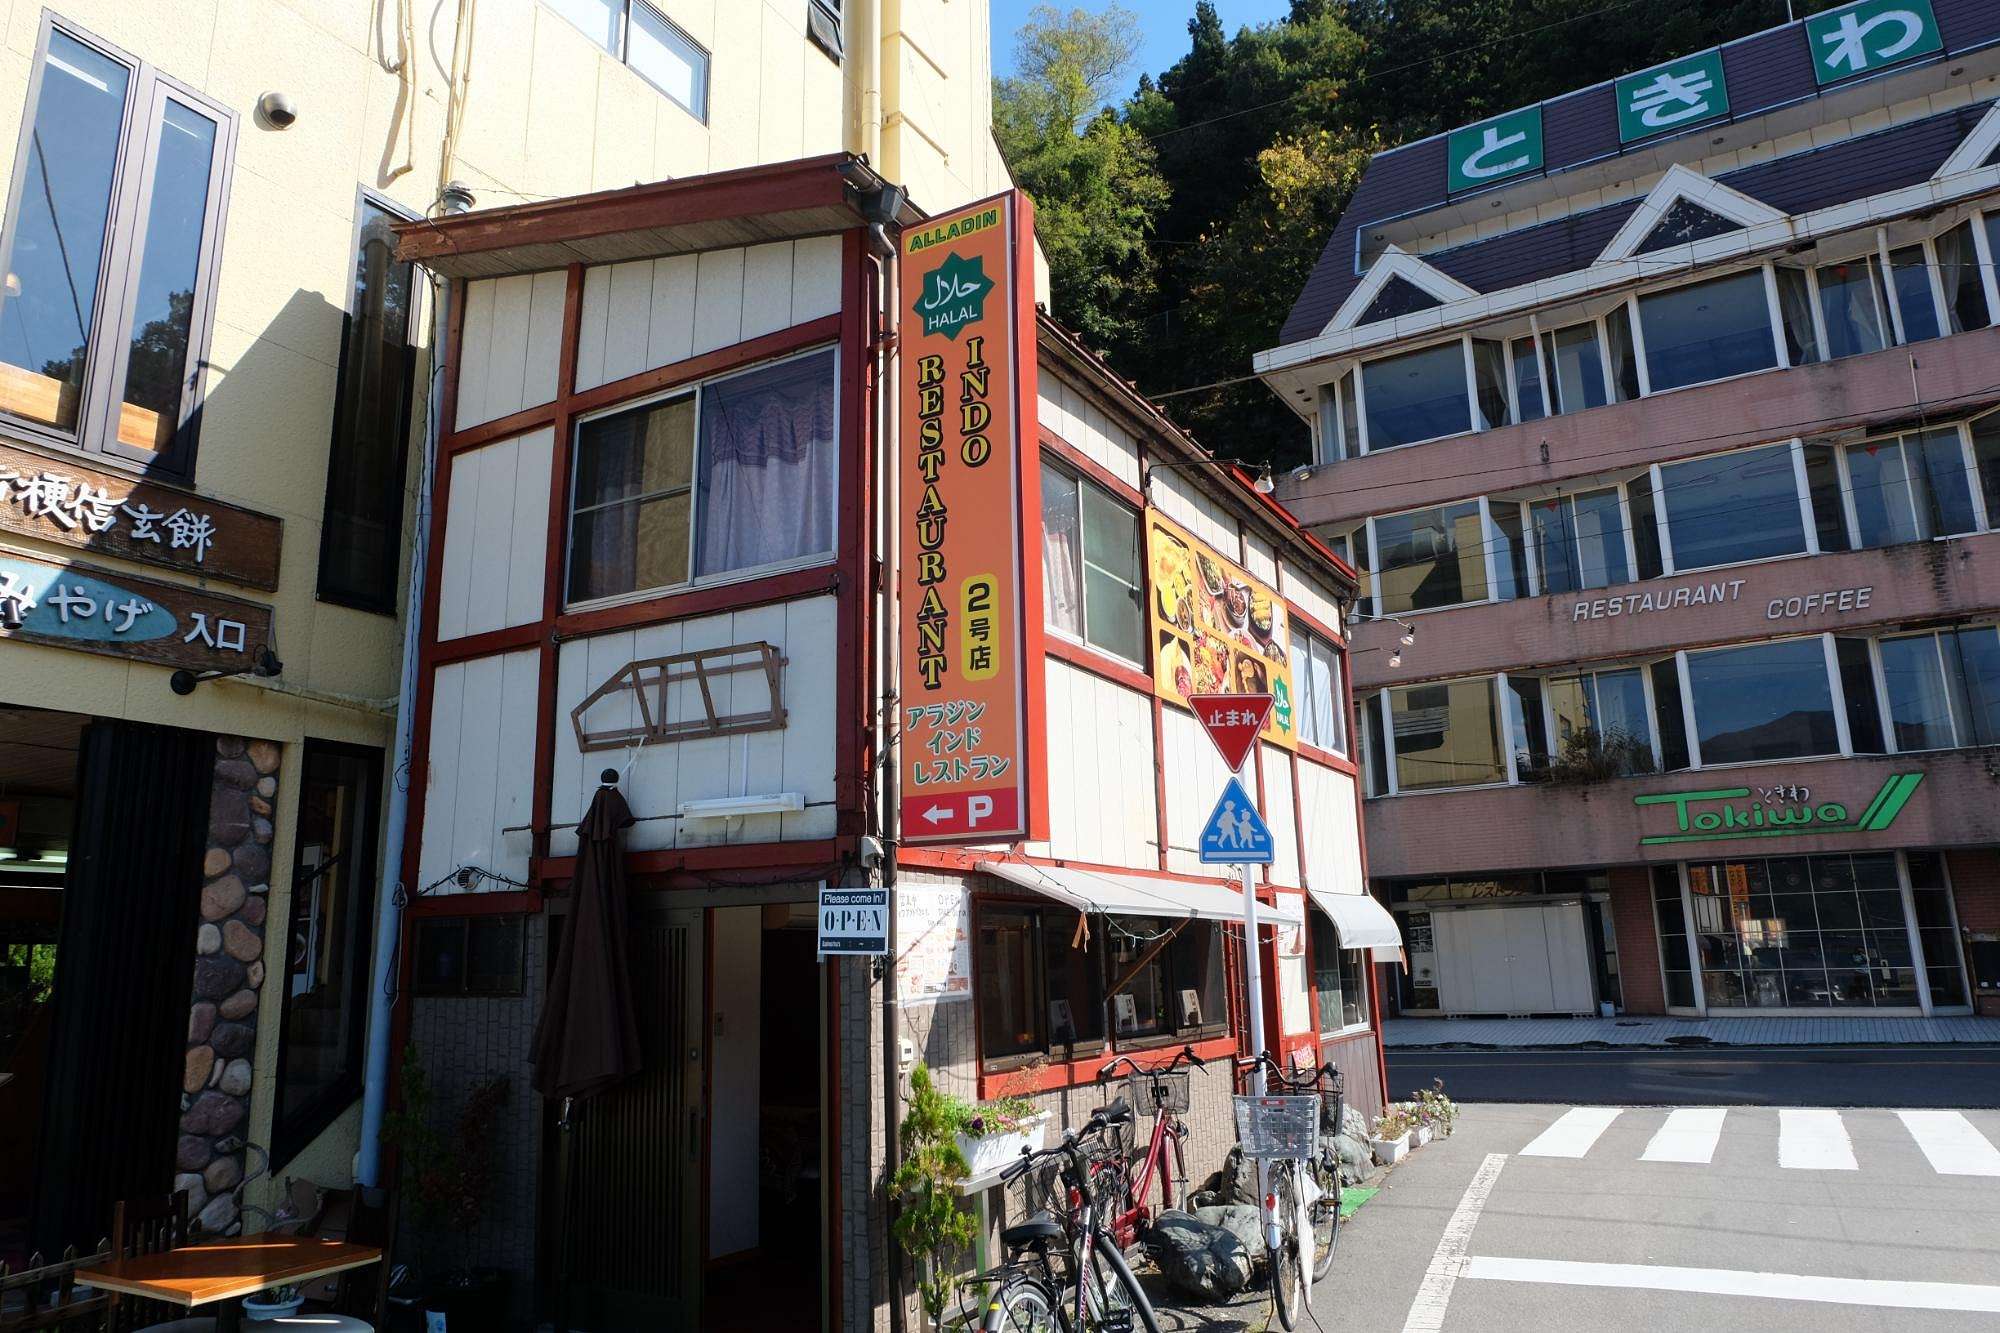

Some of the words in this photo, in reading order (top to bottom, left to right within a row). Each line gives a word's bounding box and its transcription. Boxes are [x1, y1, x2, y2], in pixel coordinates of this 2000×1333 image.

[1461, 9, 1924, 179] ときわ
[909, 208, 997, 252] ALLADIN
[924, 272, 982, 309] حلال
[928, 304, 978, 330] HALAL
[960, 337, 991, 468] INDO
[917, 355, 948, 690] RESTAURANT
[1573, 579, 1746, 622] RESTAURANT
[1767, 587, 1872, 620] COFFEE
[184, 612, 246, 652] 入口
[967, 582, 991, 671] 2号店
[907, 701, 986, 729] アラジン
[1208, 709, 1259, 727] 止まれ
[927, 727, 982, 754] インド
[913, 754, 1010, 785] レストラン
[967, 795, 993, 827] P
[1634, 788, 1848, 831] Tokiwa
[1759, 784, 1809, 803] ときわ
[824, 894, 849, 904] Please
[851, 896, 871, 904] come
[873, 894, 883, 903] in!
